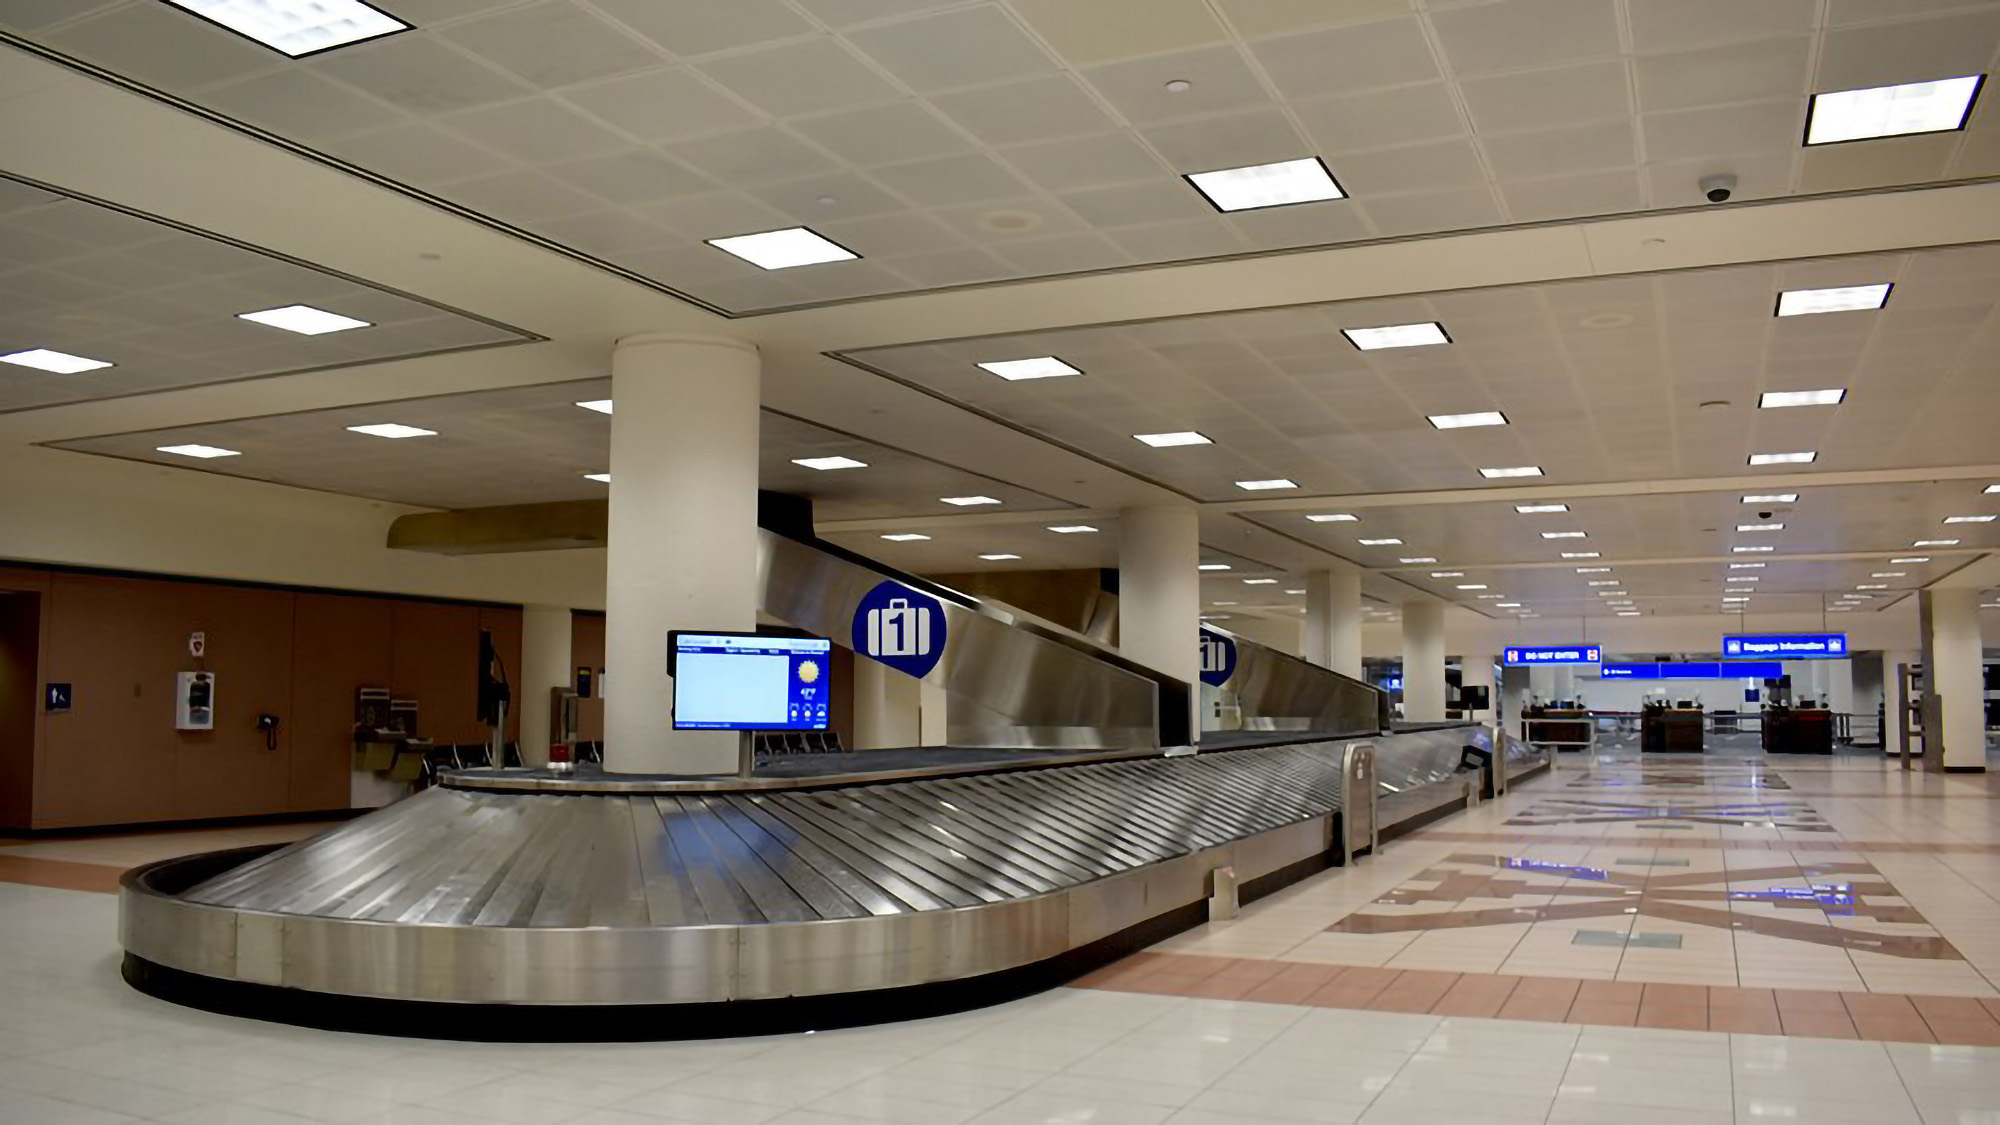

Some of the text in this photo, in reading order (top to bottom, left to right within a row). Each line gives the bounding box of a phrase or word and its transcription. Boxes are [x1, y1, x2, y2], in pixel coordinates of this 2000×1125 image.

[889, 612, 904, 652] 1
[1743, 642, 1825, 652] Baggage Information
[1525, 651, 1580, 660] DO NOT ENTER
